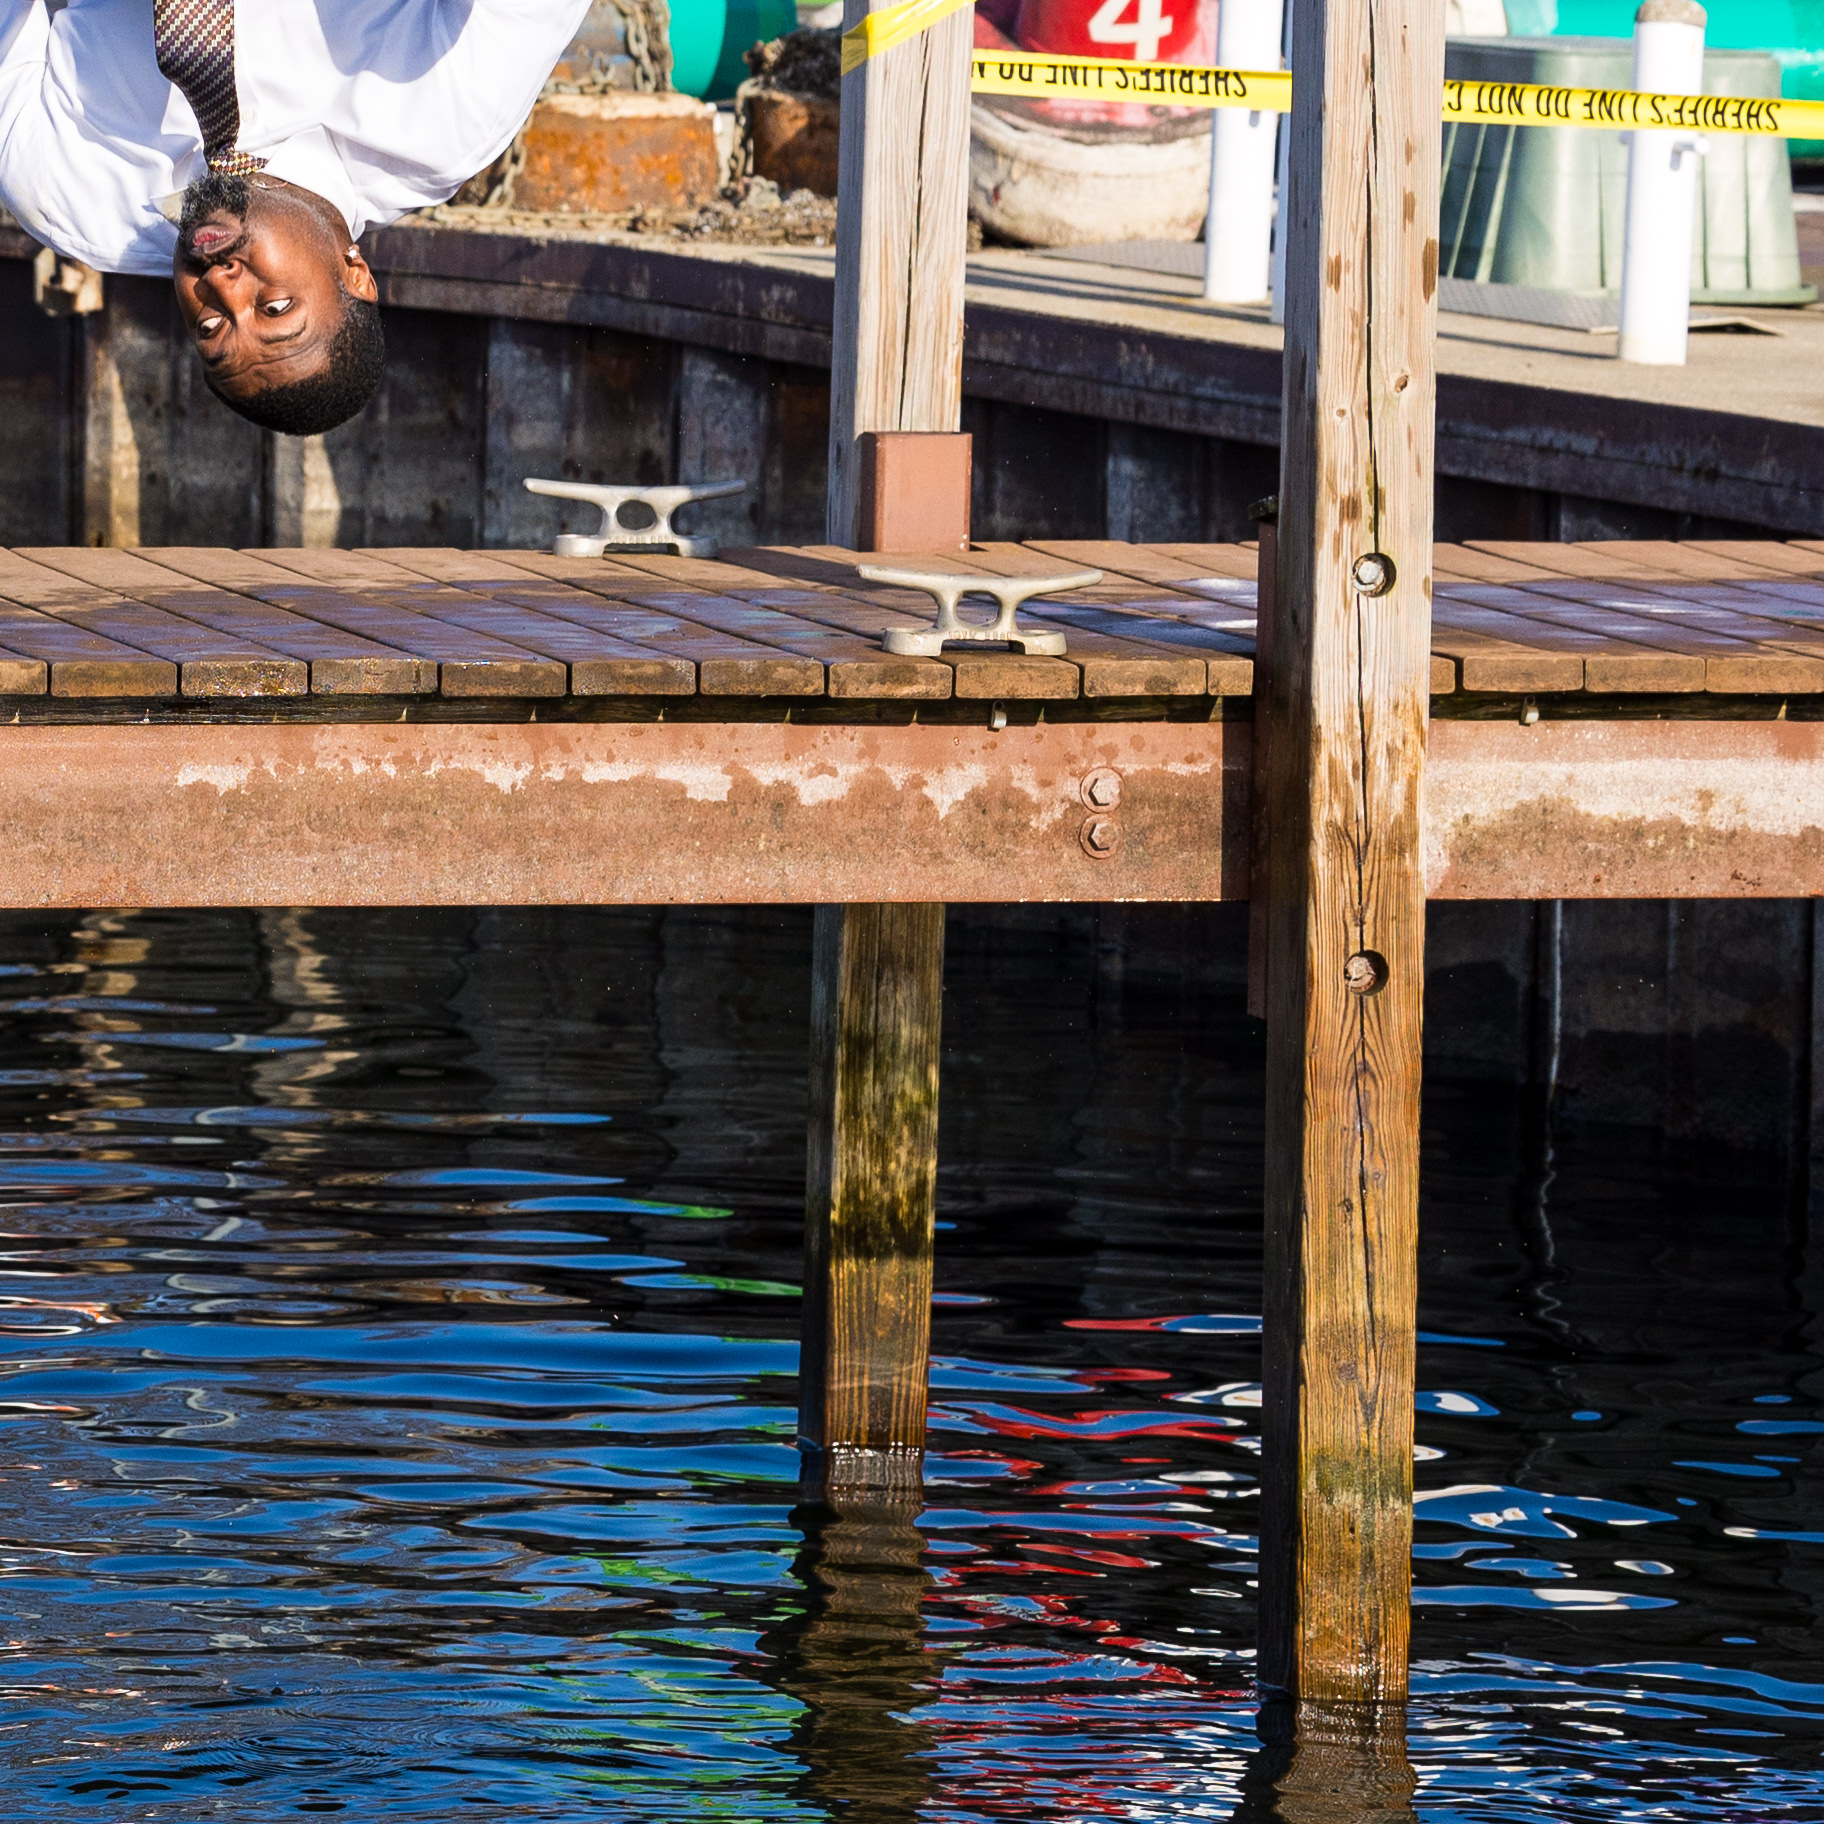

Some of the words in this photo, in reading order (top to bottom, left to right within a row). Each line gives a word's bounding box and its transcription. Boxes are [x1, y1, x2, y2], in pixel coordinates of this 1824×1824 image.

[1473, 83, 1526, 117] NOT
[1534, 87, 1572, 120] DO
[1581, 90, 1642, 123] LINE
[1649, 93, 1782, 132] SHERIFF'S
